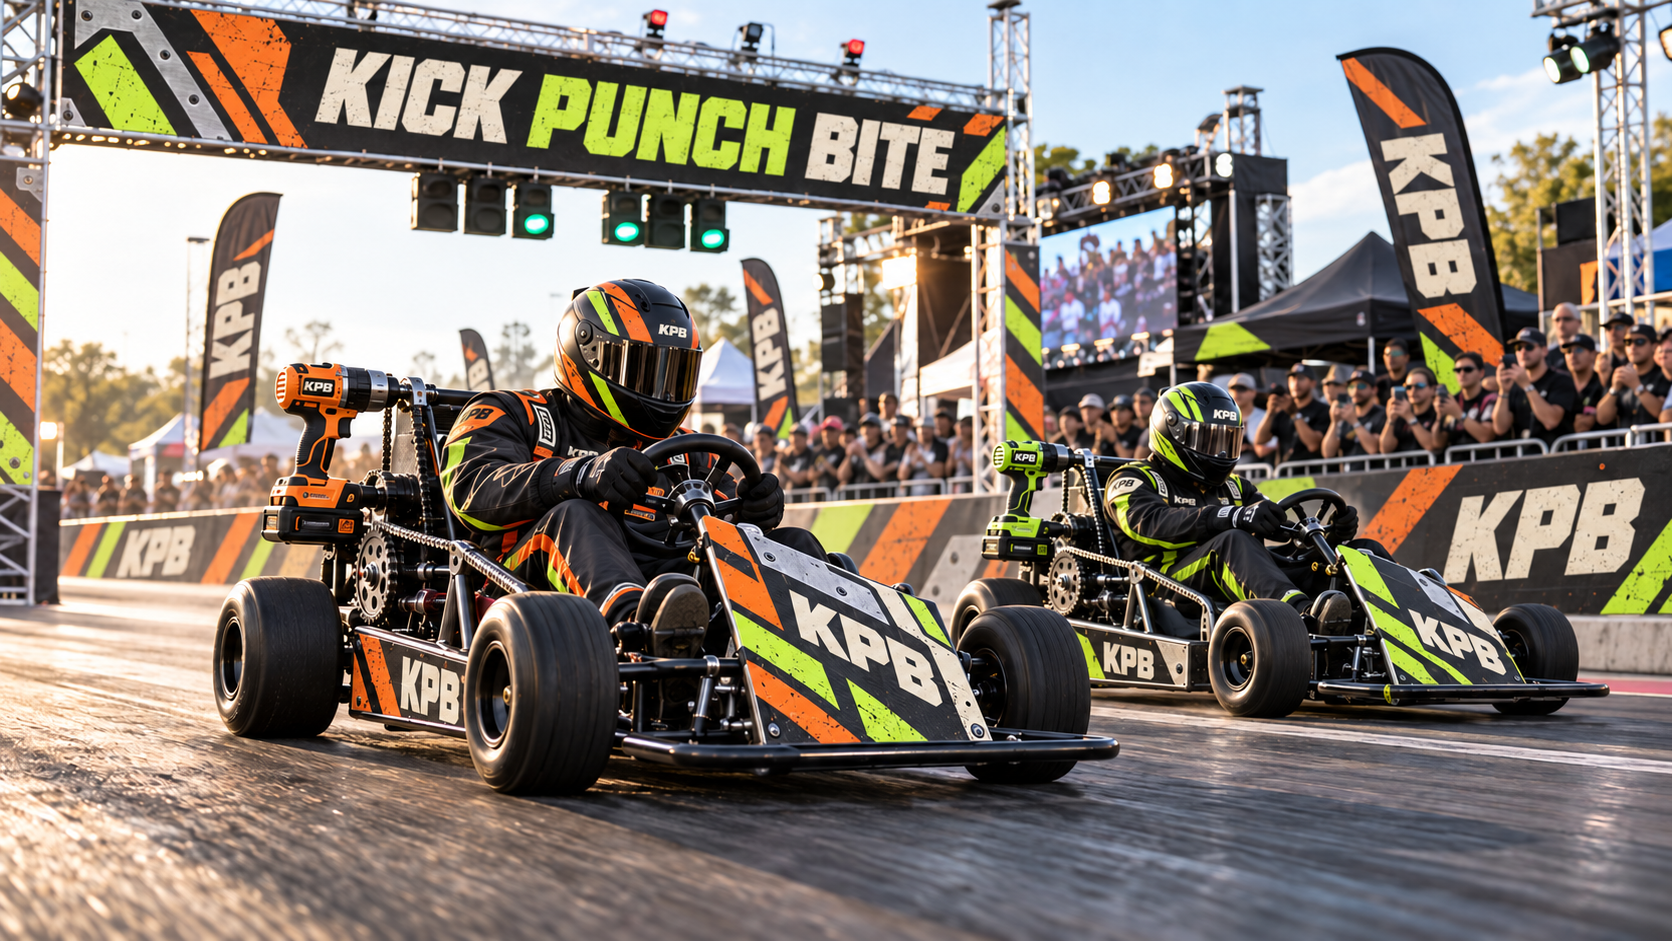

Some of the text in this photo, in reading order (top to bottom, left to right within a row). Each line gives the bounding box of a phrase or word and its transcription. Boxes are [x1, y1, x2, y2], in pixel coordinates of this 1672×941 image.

[314, 48, 955, 196] KICK PUNCH BITE
[1380, 133, 1477, 298] KPB
[209, 261, 261, 379] KPB
[658, 323, 687, 338] KPB
[752, 307, 786, 400] KPB
[303, 381, 333, 393] KPB
[1213, 409, 1237, 421] KPB
[1014, 453, 1036, 463] KPB
[1111, 479, 1135, 491] KPB
[1174, 495, 1196, 506] KPB
[1443, 477, 1646, 584] KPB
[116, 525, 196, 578] KPB
[789, 589, 943, 707] KPB
[1103, 641, 1155, 680] KPB
[1408, 608, 1506, 675] KPB
[400, 656, 460, 725] KPB
